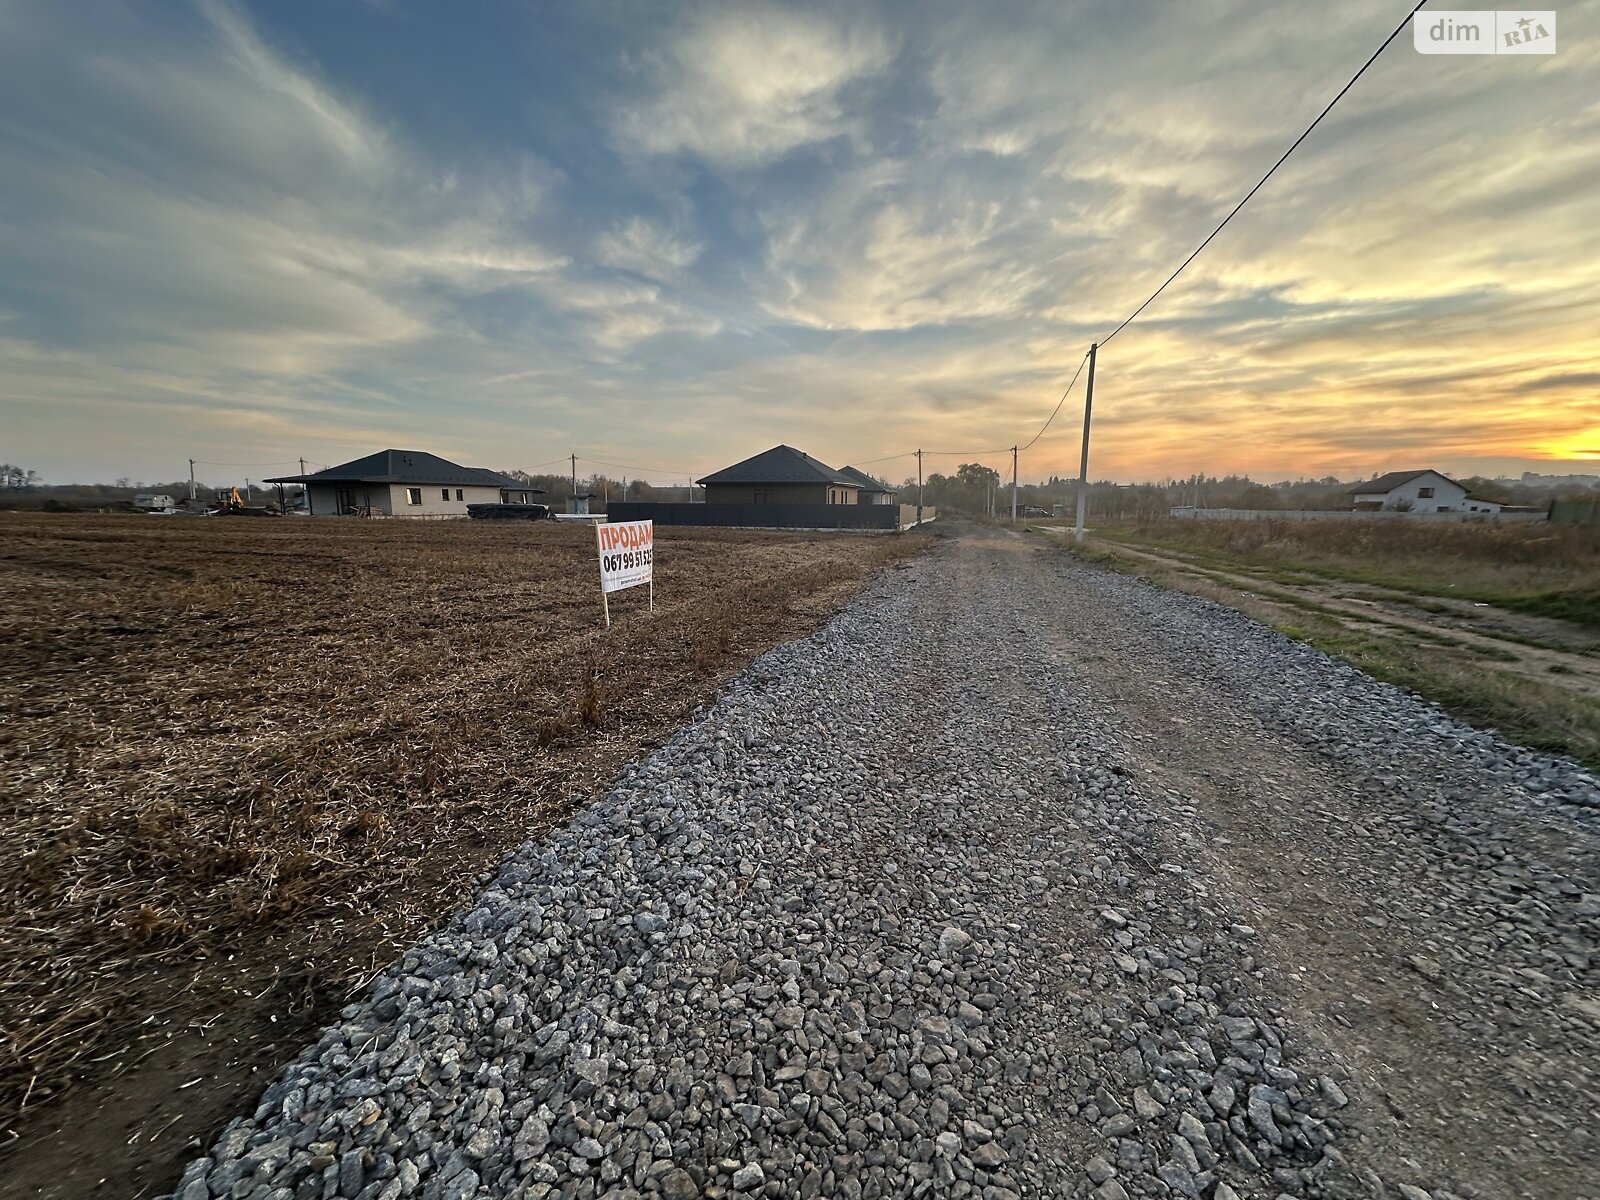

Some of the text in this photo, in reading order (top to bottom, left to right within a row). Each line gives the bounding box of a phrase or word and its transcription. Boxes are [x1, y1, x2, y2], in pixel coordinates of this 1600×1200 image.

[600, 524, 652, 550] ПРОДАМ
[603, 553, 622, 573] 067
[623, 552, 634, 570] 99
